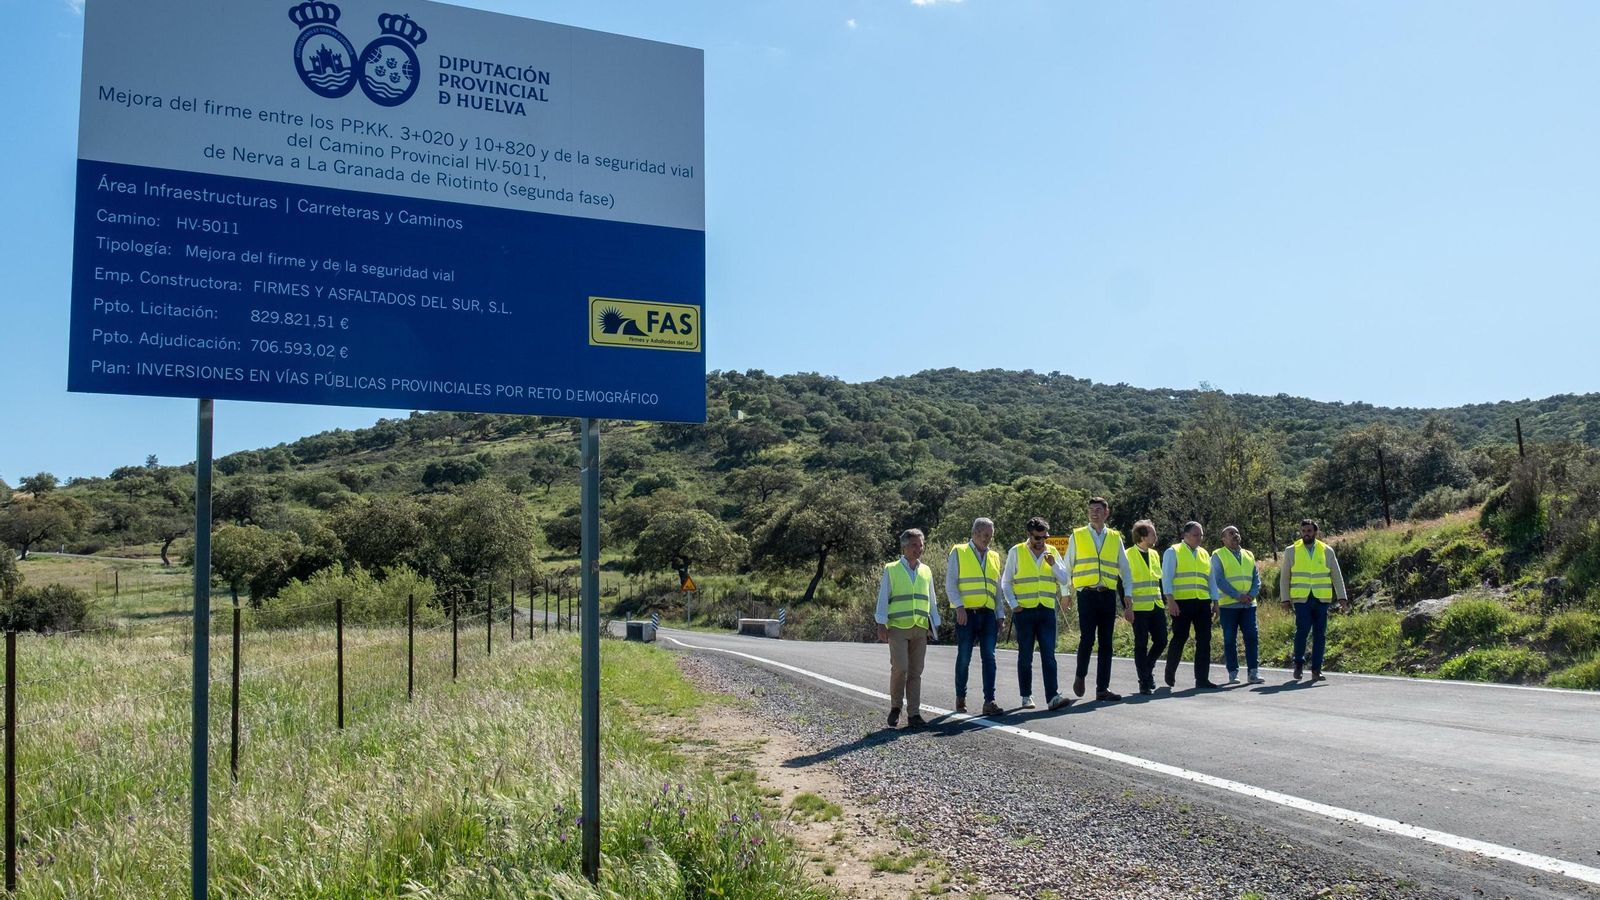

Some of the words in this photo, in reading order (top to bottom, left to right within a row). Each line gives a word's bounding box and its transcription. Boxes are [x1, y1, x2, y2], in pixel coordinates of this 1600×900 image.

[439, 55, 549, 86] DIPUTACIÓN
[439, 73, 549, 102] PROVINCIAL
[457, 93, 527, 116] HUELVA
[99, 86, 162, 107] Mejora
[170, 96, 196, 112] del
[204, 100, 252, 119] firme
[259, 110, 303, 126] entre
[311, 114, 333, 130] los
[401, 127, 453, 146] 3+020
[460, 138, 468, 151] y
[475, 137, 536, 157] 10+820
[541, 150, 549, 162] y
[554, 149, 571, 162] de
[578, 151, 589, 164] la
[595, 157, 665, 174] seguridad
[671, 166, 693, 178] vial
[287, 133, 312, 148] del
[320, 137, 384, 157] Camino
[391, 146, 468, 169] Provincial
[475, 158, 547, 180] HV-5011,
[204, 144, 225, 159] de
[233, 147, 283, 166] Nerva
[291, 158, 299, 168] a
[308, 156, 326, 171] La
[334, 159, 405, 181] Granada
[411, 170, 430, 184] de
[437, 172, 498, 192] Riotinto
[504, 181, 573, 201] (segunda
[579, 190, 614, 209] fase)
[98, 174, 136, 193] Área
[145, 181, 278, 208] Infraestructuras
[298, 199, 379, 220] Carreteras
[385, 212, 393, 224] y
[399, 210, 463, 229] Caminos
[97, 209, 160, 226] Camino:
[177, 217, 238, 234] HV-5011
[96, 236, 171, 256] Tipología:
[186, 245, 235, 261] Mejora
[241, 251, 262, 263] del
[268, 253, 305, 267] firme
[311, 260, 318, 271] y
[323, 259, 339, 270] de
[346, 260, 356, 272] la
[362, 265, 427, 279] seguridad
[433, 271, 454, 281] vial
[95, 267, 133, 284] Emp.
[140, 271, 241, 291] Constructora:
[254, 281, 309, 296] FIRMES
[315, 286, 323, 297] Y
[328, 288, 416, 306] ASFALTADOS
[422, 296, 447, 308] DEL
[452, 298, 483, 312] SUR,
[489, 301, 512, 315] S.L.
[94, 298, 133, 314] Ppto.
[141, 301, 217, 319] Licitación:
[251, 310, 333, 328] 829.821,51
[341, 318, 348, 329] €
[647, 311, 693, 335] FAS
[93, 329, 132, 344] Ppto.
[139, 332, 240, 350] Adjudicación:
[251, 339, 334, 357] 706.593,02
[340, 347, 348, 358] €
[92, 360, 130, 374] Plan:
[138, 363, 243, 380] INVERSIONES
[250, 369, 269, 382] EN
[276, 369, 308, 384] VÍAS
[315, 372, 386, 390] PÚBLICAS
[392, 379, 491, 395] PROVINCIALES
[497, 385, 523, 397] POR
[529, 387, 561, 400] RETO
[567, 389, 658, 404] DEMOGRÁFICO
